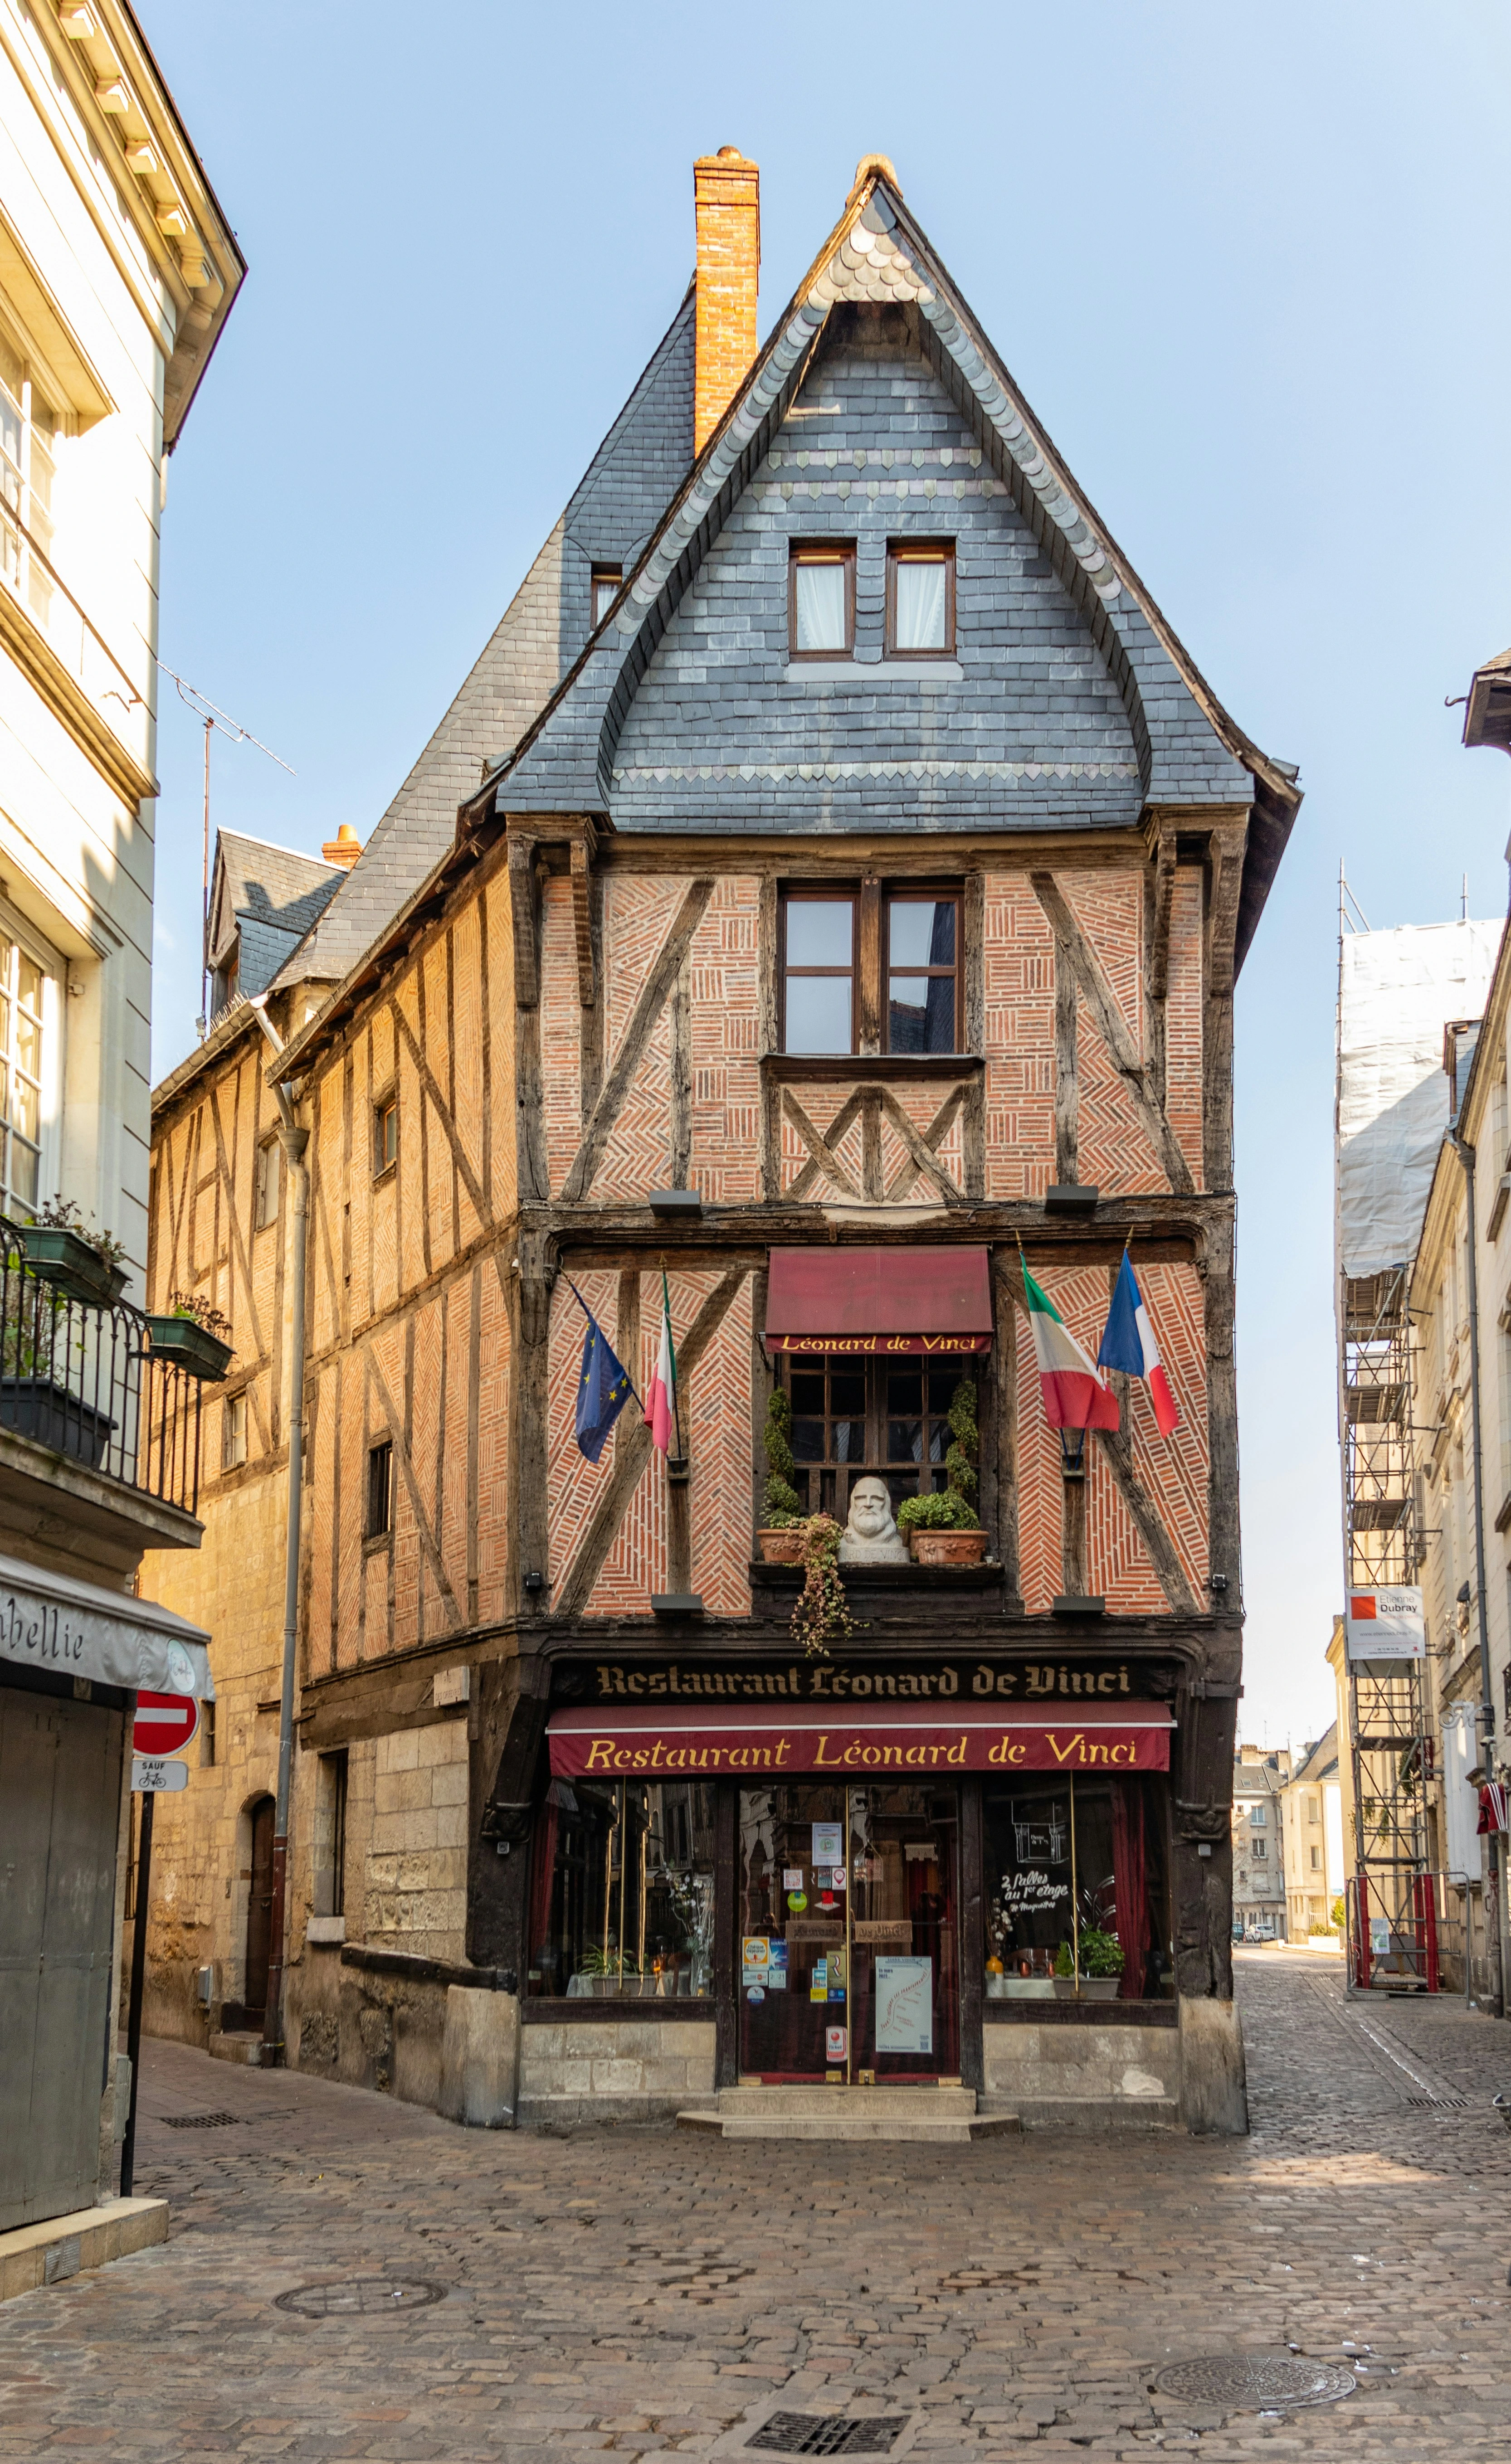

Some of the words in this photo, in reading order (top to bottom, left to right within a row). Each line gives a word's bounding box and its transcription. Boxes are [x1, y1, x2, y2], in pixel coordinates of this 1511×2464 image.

[781, 1336, 876, 1351] Léonard
[886, 1336, 910, 1350] de
[921, 1335, 975, 1350] Vinci
[865, 1550, 876, 1559] DE
[1379, 1594, 1414, 1604] Etienne
[1380, 1604, 1418, 1613] Dubray
[596, 1666, 800, 1697] Restaurant
[810, 1667, 958, 1697] Léonard
[973, 1665, 1018, 1695] de
[1025, 1666, 1131, 1697] Vinci
[585, 1738, 791, 1769] Restaurant
[813, 1736, 967, 1764] Léonard
[988, 1736, 1026, 1763] de
[1045, 1734, 1137, 1763] Vinci
[1023, 1886, 1036, 1899] 1er
